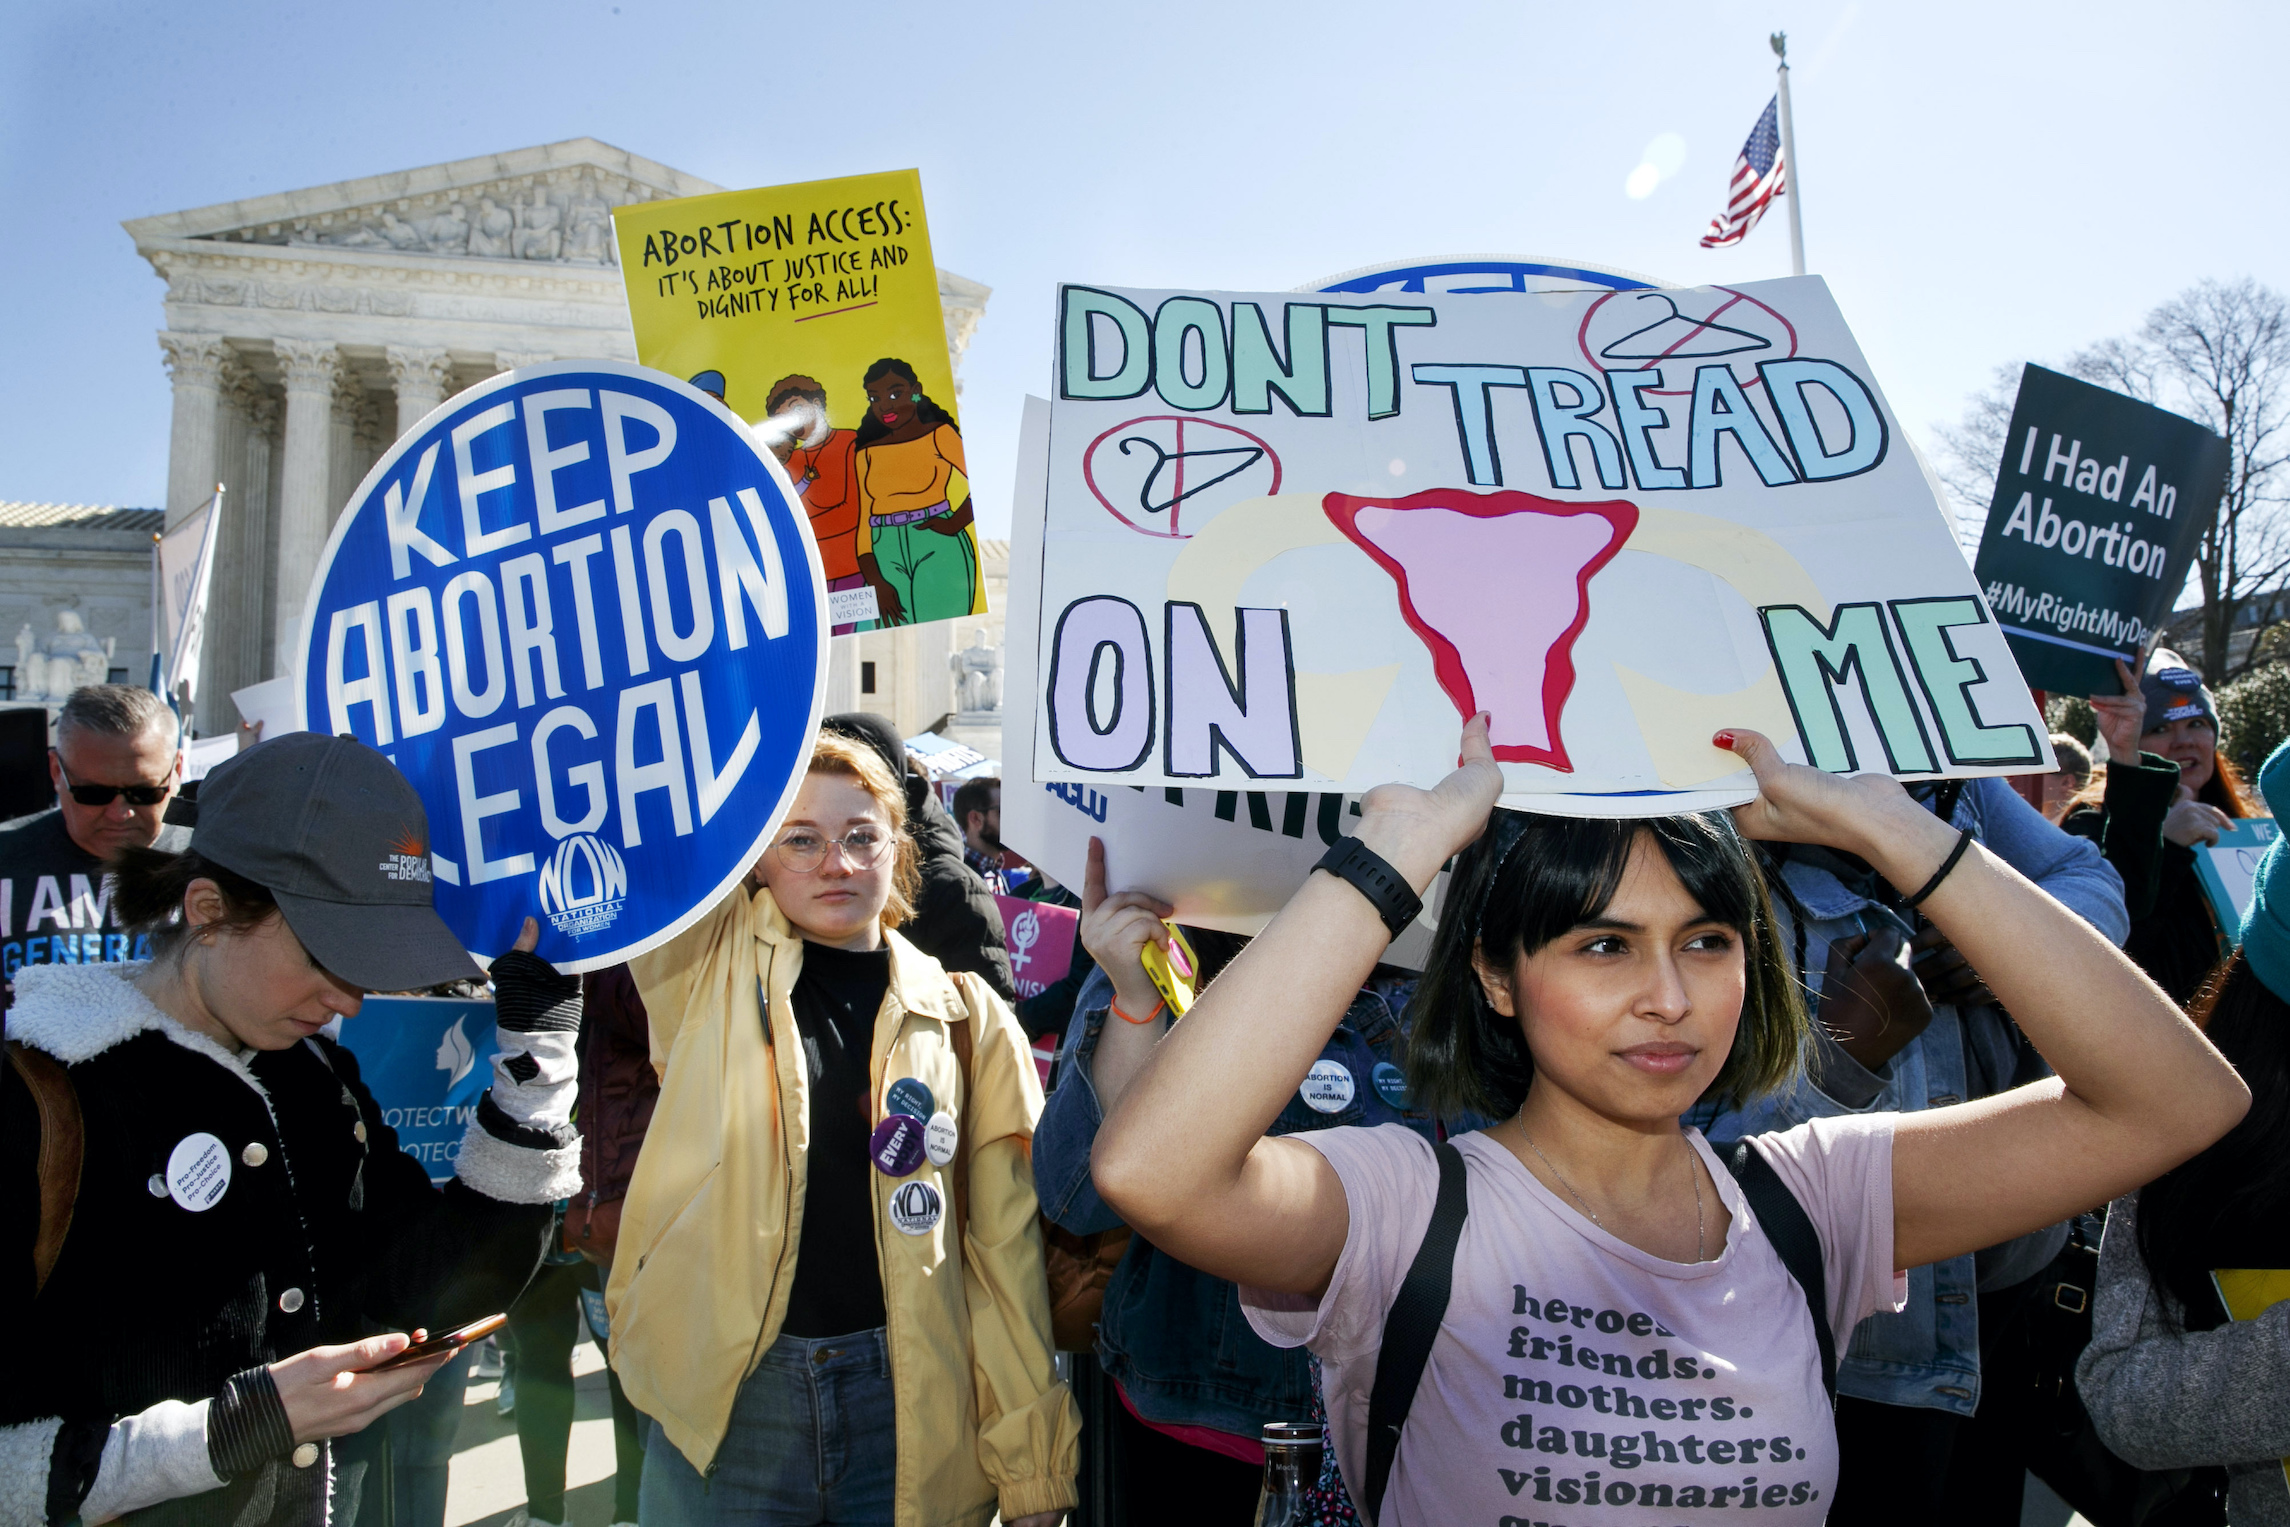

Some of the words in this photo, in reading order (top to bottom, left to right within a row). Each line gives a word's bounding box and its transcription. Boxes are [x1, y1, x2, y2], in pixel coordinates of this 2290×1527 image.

[643, 213, 794, 267] ABORTION
[808, 200, 912, 245] ACCESS:
[658, 270, 699, 298] IT'S
[707, 259, 774, 292] ABOUT
[784, 251, 863, 283] JUSTICE
[870, 244, 909, 270] AND
[697, 288, 779, 320] DIGNITY
[787, 283, 830, 310] FOR
[836, 274, 878, 302] ALL!
[1060, 284, 1438, 421] DONT
[1412, 357, 1890, 490] TREAD
[384, 388, 677, 581] KEEP
[2018, 425, 2039, 475] I
[2043, 433, 2129, 502] Had
[2129, 464, 2177, 520] An
[2001, 491, 2167, 580] Abortion
[325, 487, 790, 746] ABORTION
[830, 591, 873, 604] WOMEN
[836, 607, 872, 619] VISION
[1047, 594, 1304, 779] ON
[1757, 594, 2044, 775] ME
[2250, 823, 2275, 841] WE
[379, 862, 399, 871] CENTER
[388, 871, 398, 880] FOR
[389, 854, 399, 863] THE
[539, 835, 628, 915] NOW
[1, 878, 13, 938] I
[26, 872, 122, 932] AM
[551, 902, 623, 923] NATIONAL
[558, 912, 618, 931] ORGANIZATION
[567, 927, 581, 935] FOR
[582, 921, 611, 932] WOMEN
[2, 933, 155, 980] GENERA
[895, 1086, 905, 1095] MY
[904, 1092, 923, 1110] RIGHT,
[1305, 1074, 1350, 1082] ABORTION
[1309, 1092, 1347, 1101] NORMAL
[891, 1093, 901, 1102] MY
[900, 1100, 927, 1121] DECISION
[880, 1121, 908, 1167] EVERY
[929, 1144, 952, 1156] NORMAL
[930, 1124, 956, 1138] ABORTION
[893, 1182, 940, 1218] NOW
[1505, 1326, 1716, 1380] friends.
[1503, 1374, 1753, 1421] mothers.
[1500, 1414, 1806, 1469] daughters.
[1497, 1466, 1819, 1509] visionaries.
